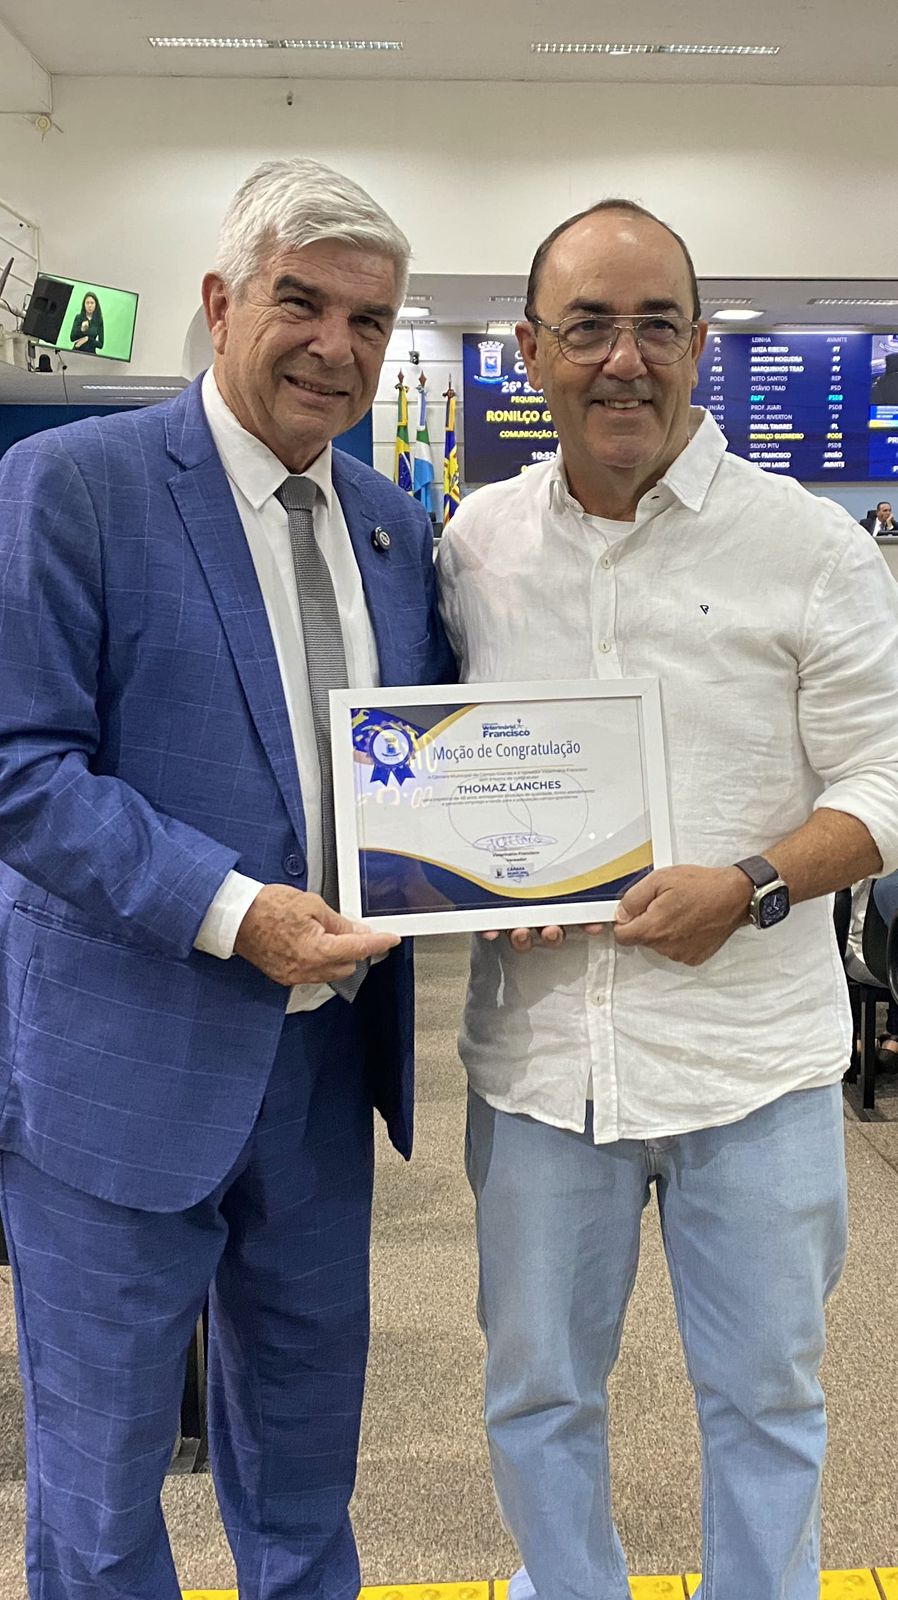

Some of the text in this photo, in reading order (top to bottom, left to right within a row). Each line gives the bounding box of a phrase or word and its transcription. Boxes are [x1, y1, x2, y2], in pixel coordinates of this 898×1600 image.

[486, 410, 540, 424] RONILÇO
[499, 430, 552, 439] COMUNICAÇÃO
[482, 729, 530, 738] Francisco
[433, 740, 581, 763] Moção de Congratulação
[457, 780, 562, 794] THOMAZ LANCHES
